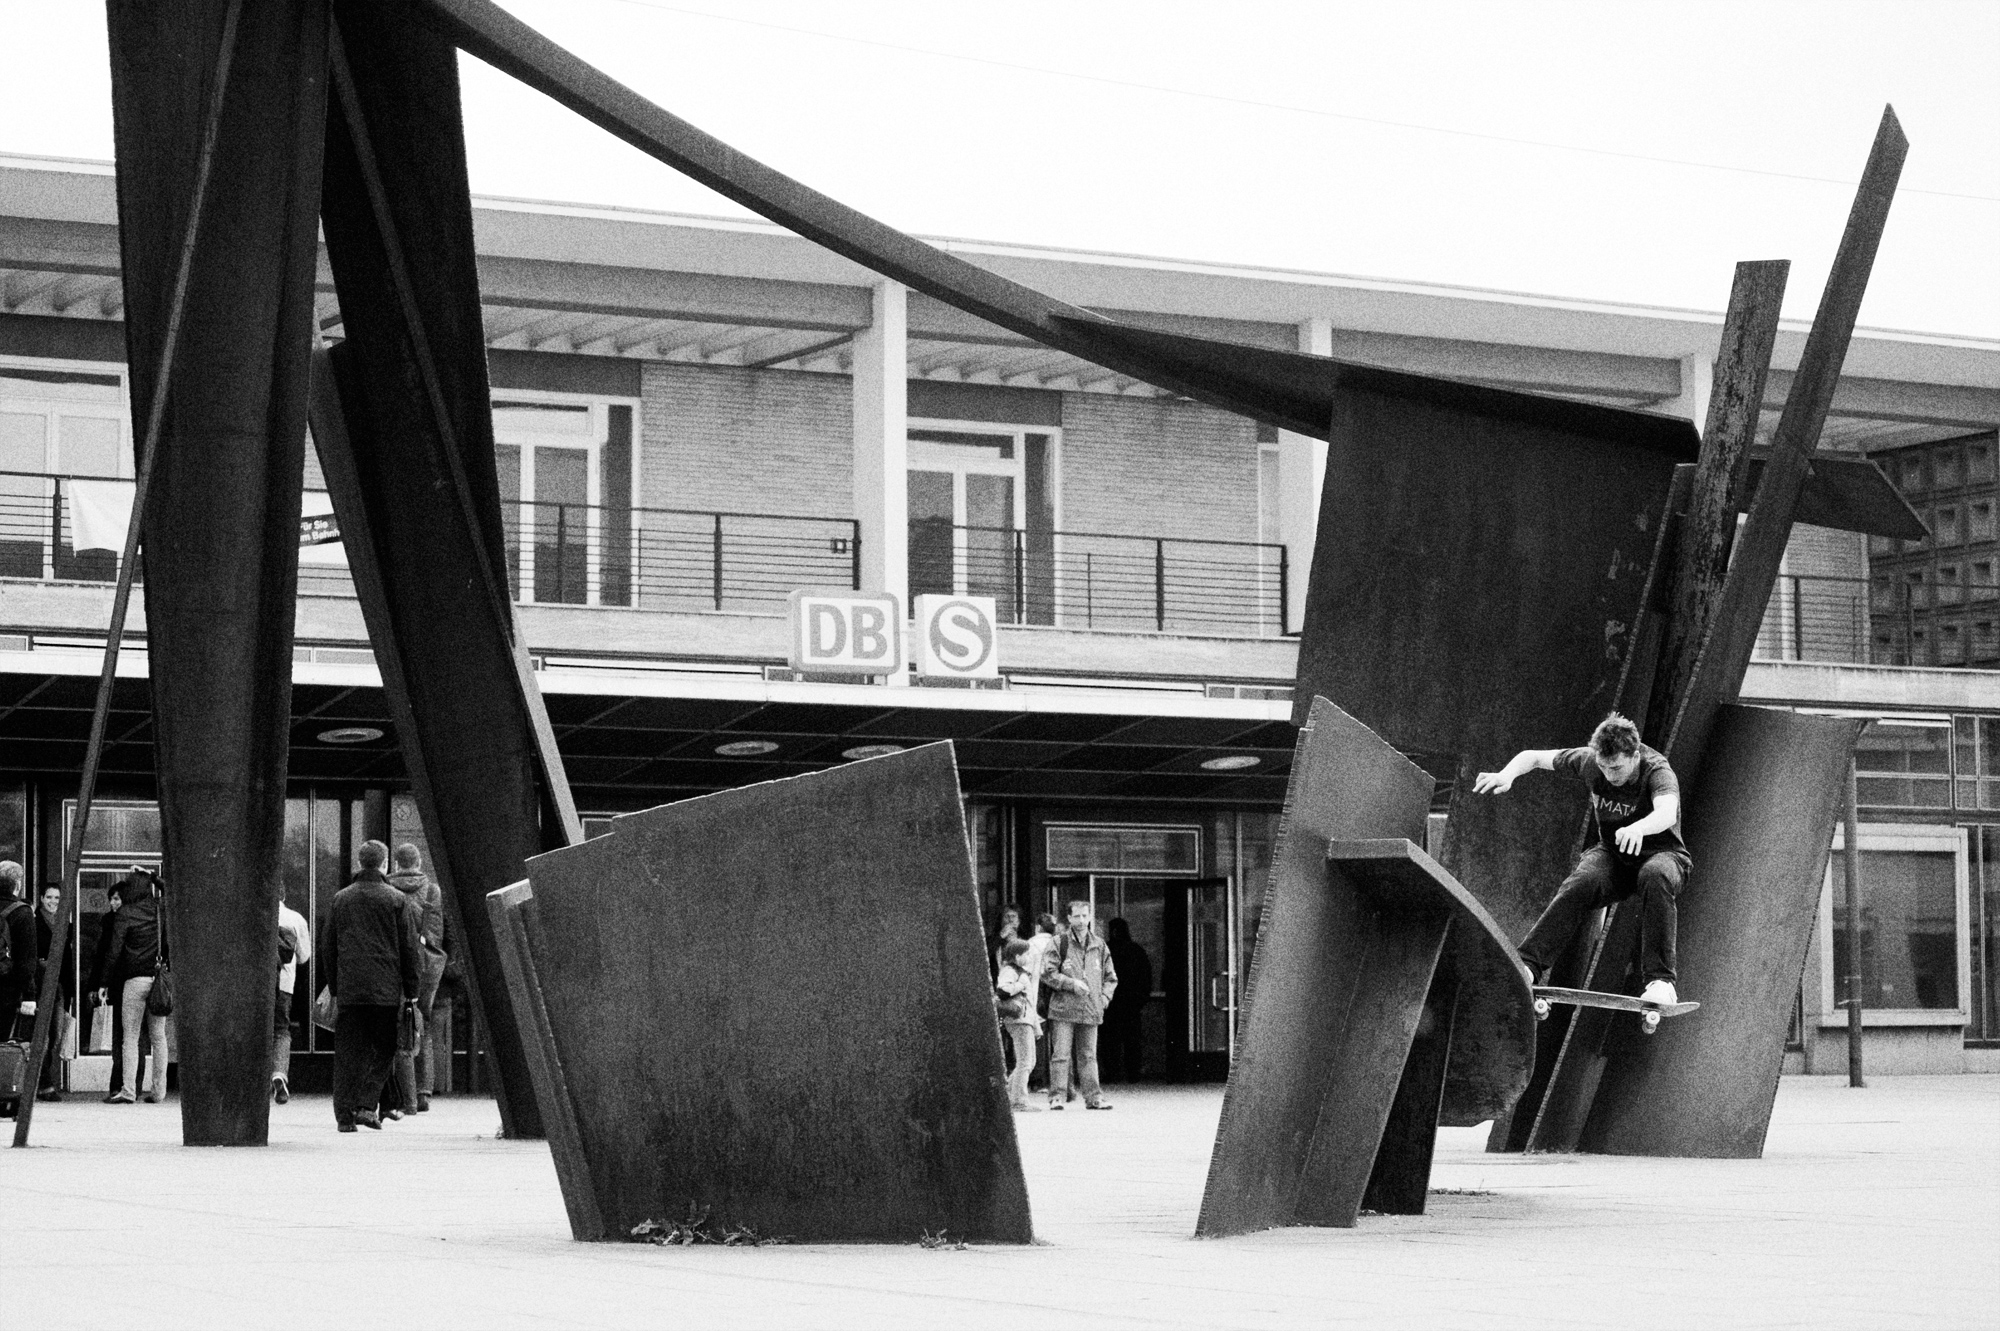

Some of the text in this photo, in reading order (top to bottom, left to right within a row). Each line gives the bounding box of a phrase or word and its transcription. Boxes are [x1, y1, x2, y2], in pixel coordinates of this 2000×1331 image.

[313, 519, 329, 530] Sie
[809, 603, 888, 659] DB
[938, 606, 984, 667] S
[1599, 797, 1637, 817] MAT
